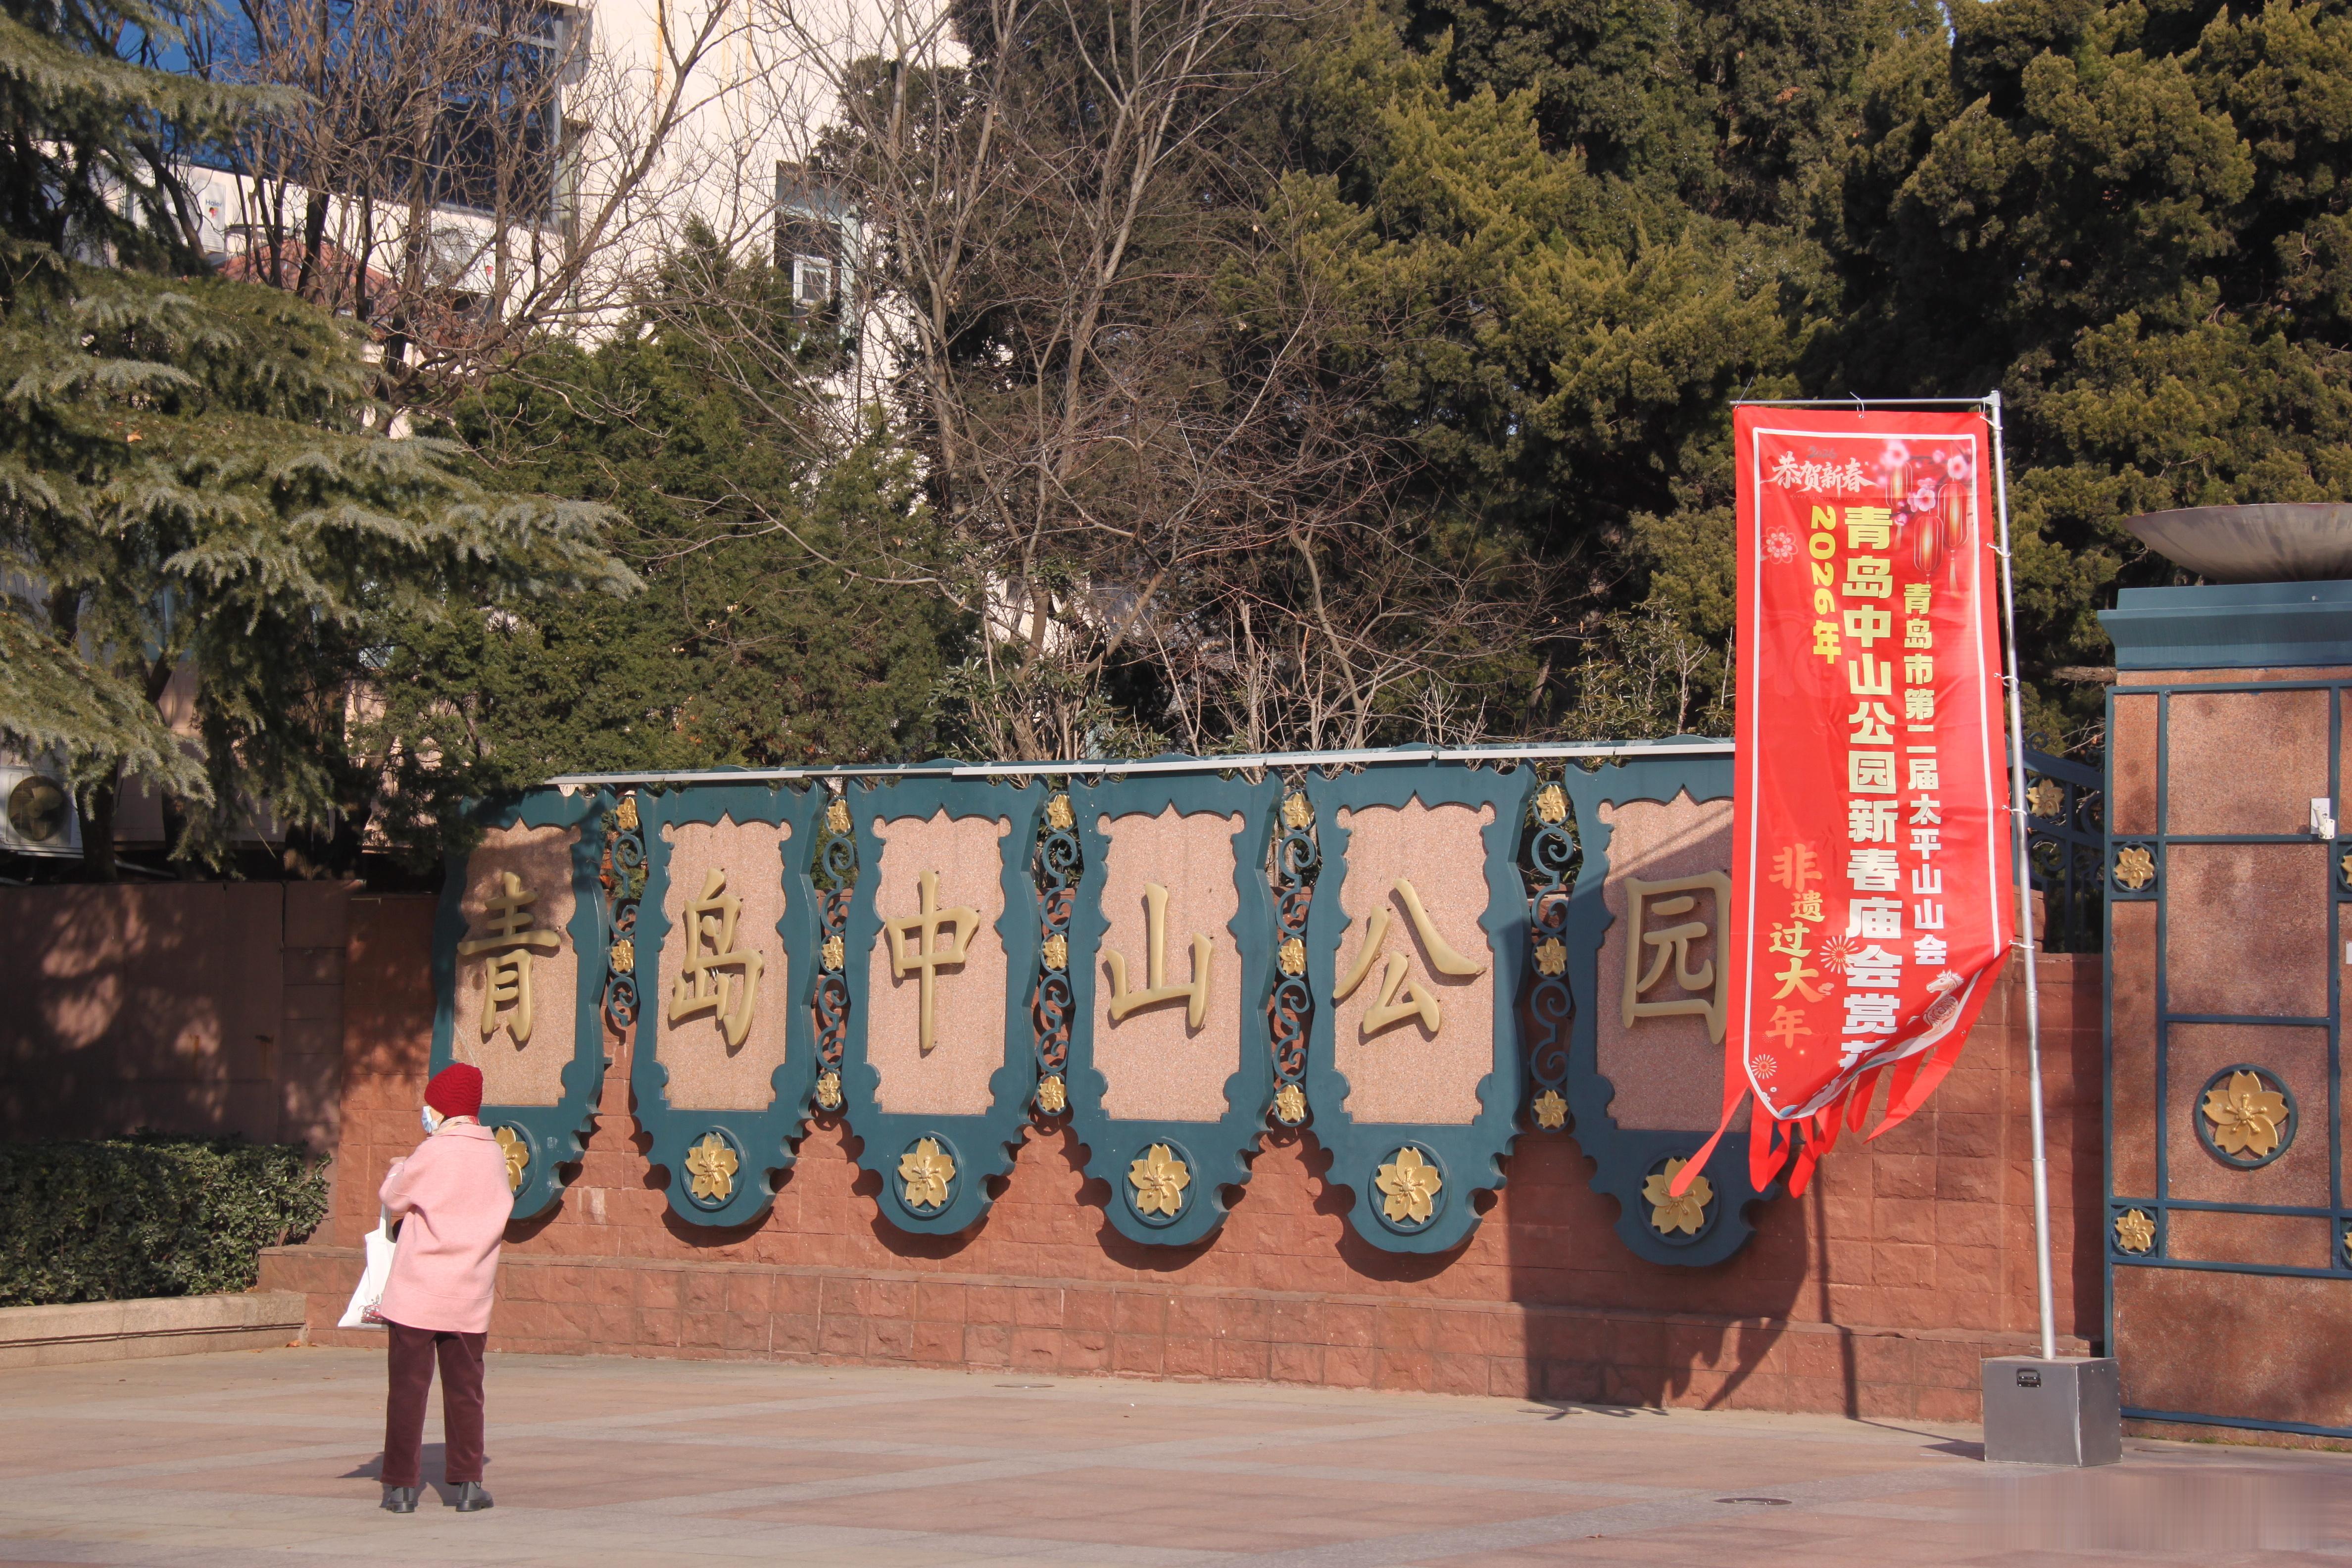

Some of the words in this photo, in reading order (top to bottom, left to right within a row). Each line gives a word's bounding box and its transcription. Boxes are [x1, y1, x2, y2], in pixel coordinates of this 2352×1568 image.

[1762, 451, 1878, 498] 恭贺新春
[1809, 505, 1842, 664] 2026年
[1903, 583, 1947, 965] 青岛市第二届太平山山会
[457, 867, 1732, 1049] 青岛中山公园
[1765, 842, 1826, 1049] 非遗过大年
